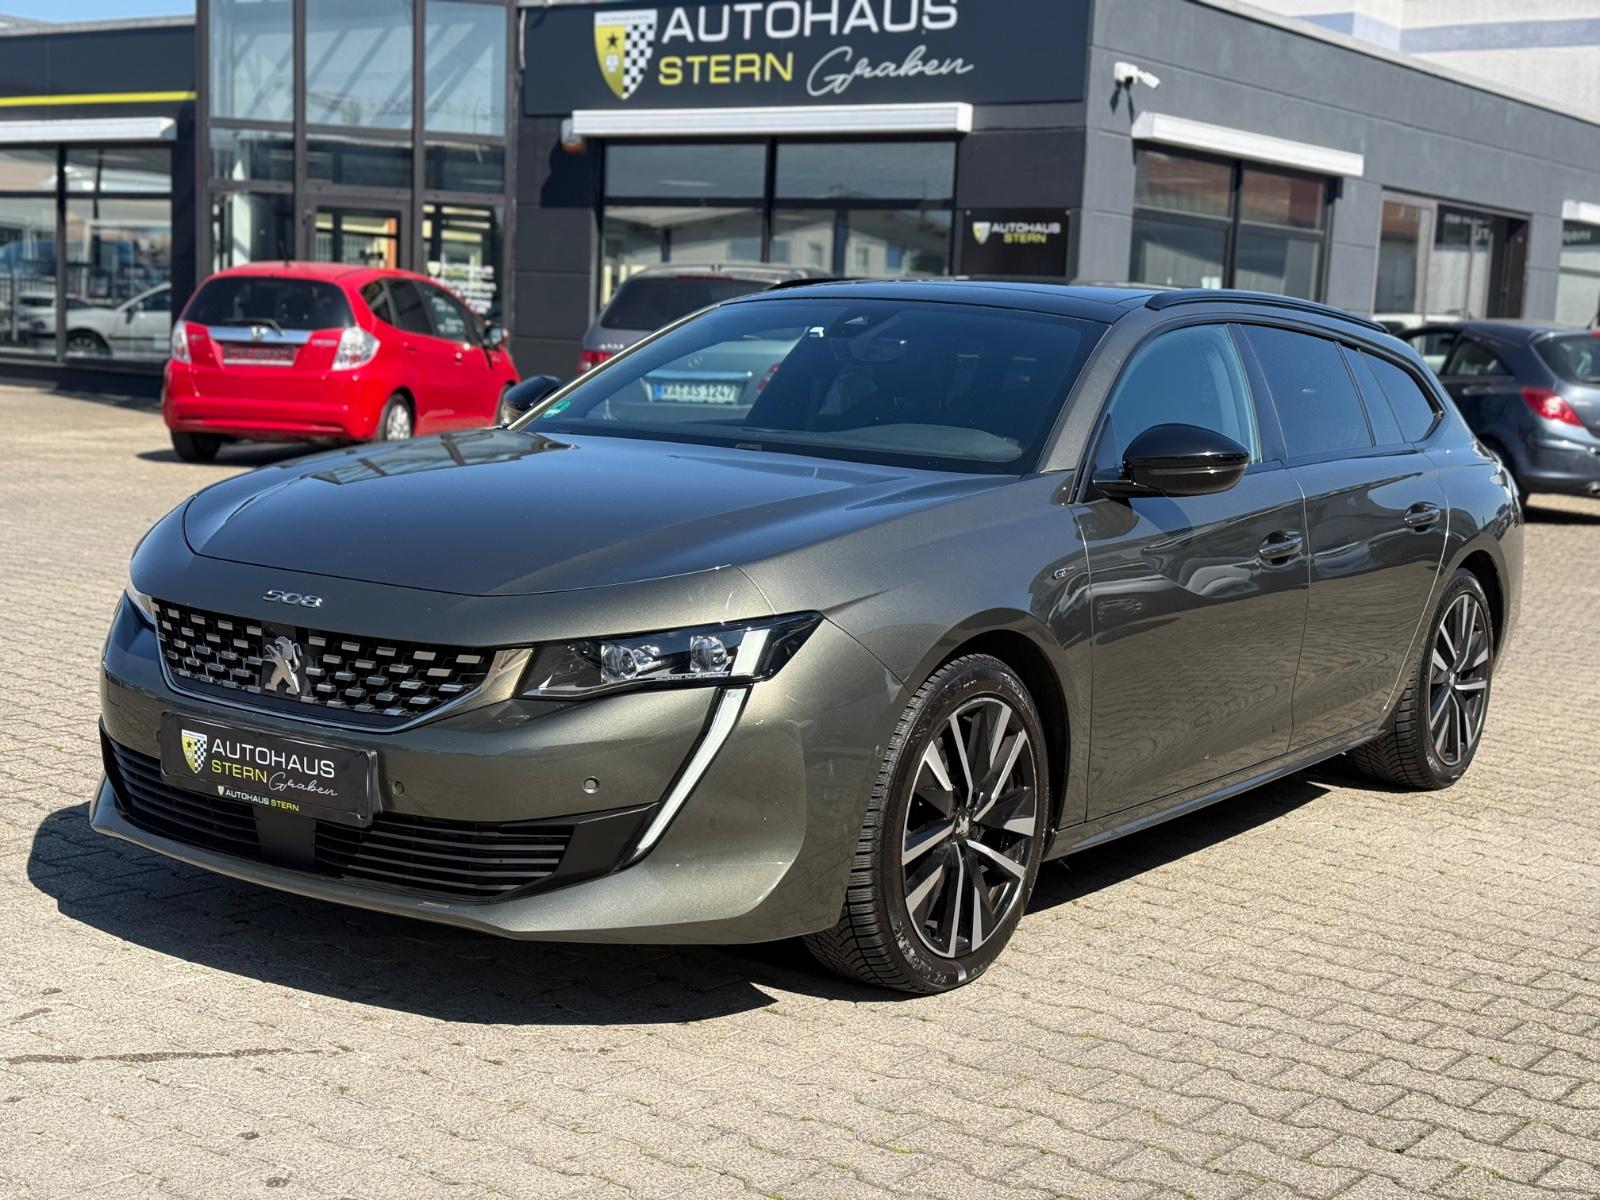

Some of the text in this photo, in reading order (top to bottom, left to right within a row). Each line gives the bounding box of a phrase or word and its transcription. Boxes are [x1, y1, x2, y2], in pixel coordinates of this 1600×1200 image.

[661, 0, 958, 43] AUTOHAUS
[658, 45, 973, 96] STERN Graben
[991, 222, 1061, 234] AUTOHAUS
[1003, 233, 1047, 243] STERN
[263, 590, 322, 608] 508
[211, 738, 335, 778] AUTOHAUS
[211, 760, 338, 796] STERN Graben
[226, 789, 300, 812] AUTOHAUS STERN
